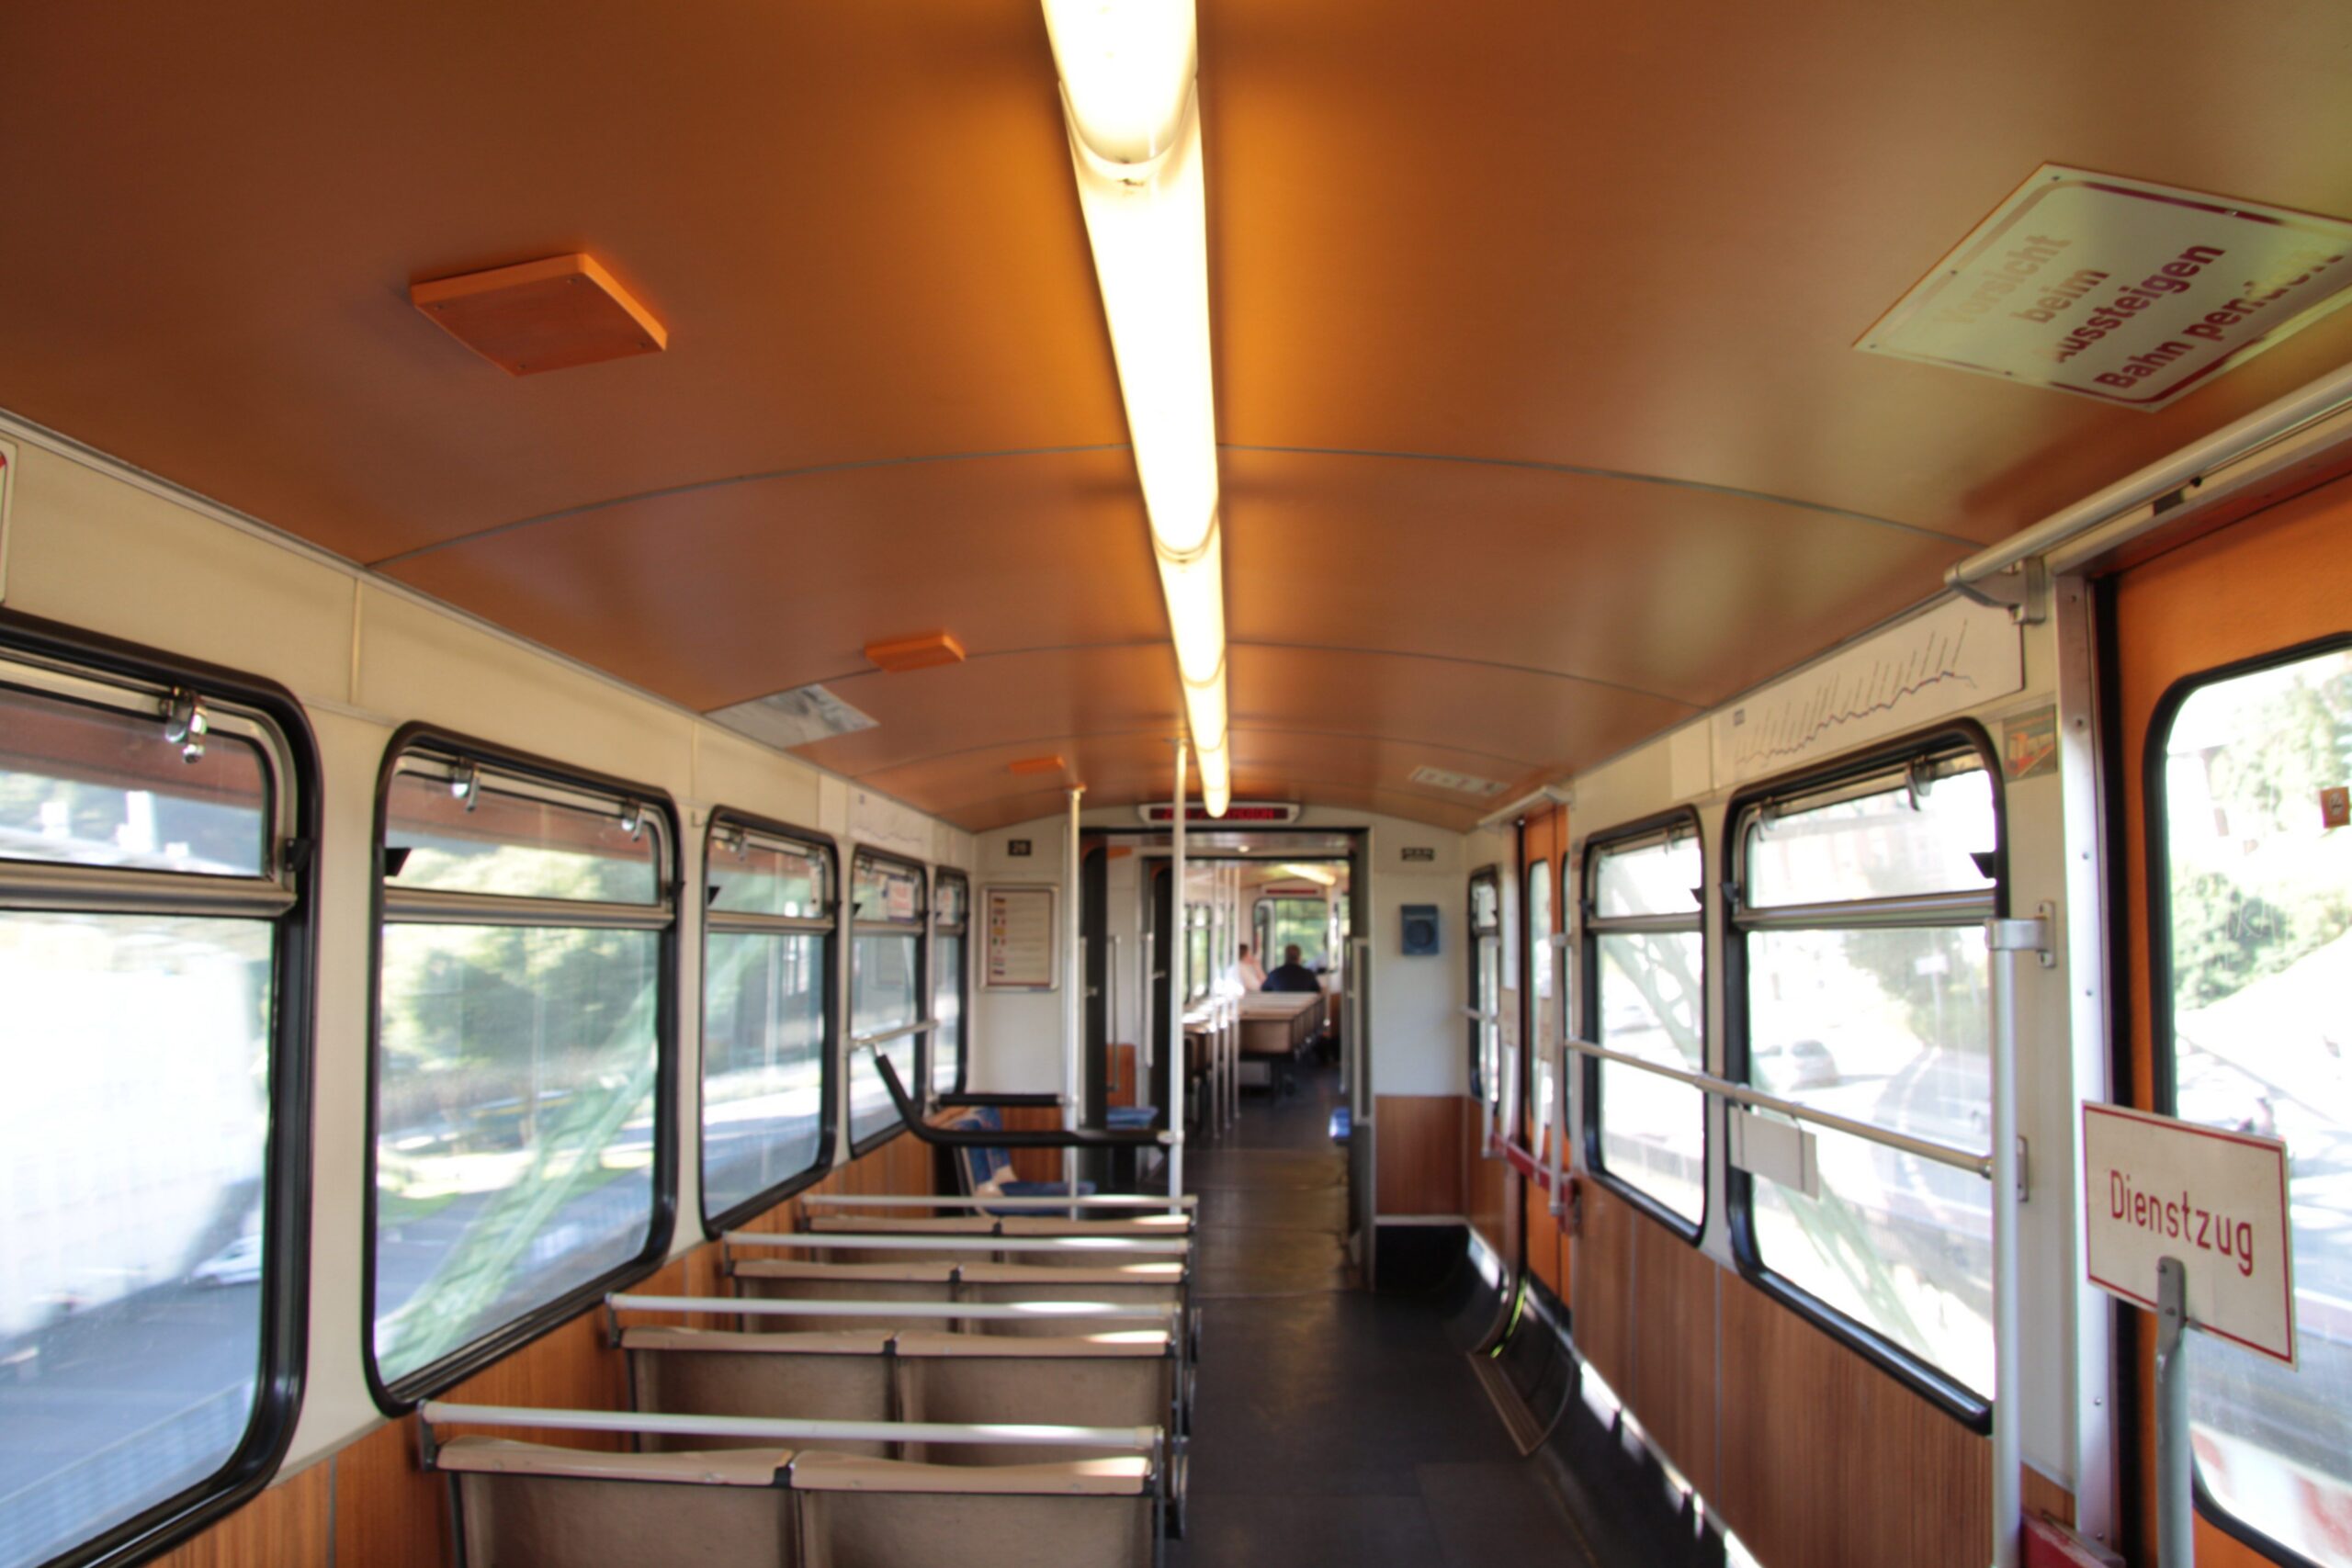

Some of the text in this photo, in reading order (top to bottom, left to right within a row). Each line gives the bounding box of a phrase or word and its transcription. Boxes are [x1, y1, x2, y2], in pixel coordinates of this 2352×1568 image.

[2009, 266, 2111, 323] beim
[2036, 243, 2226, 364] Aussteigen
[2094, 341, 2194, 389] Bahn
[2109, 1169, 2254, 1278] Dienstzug
